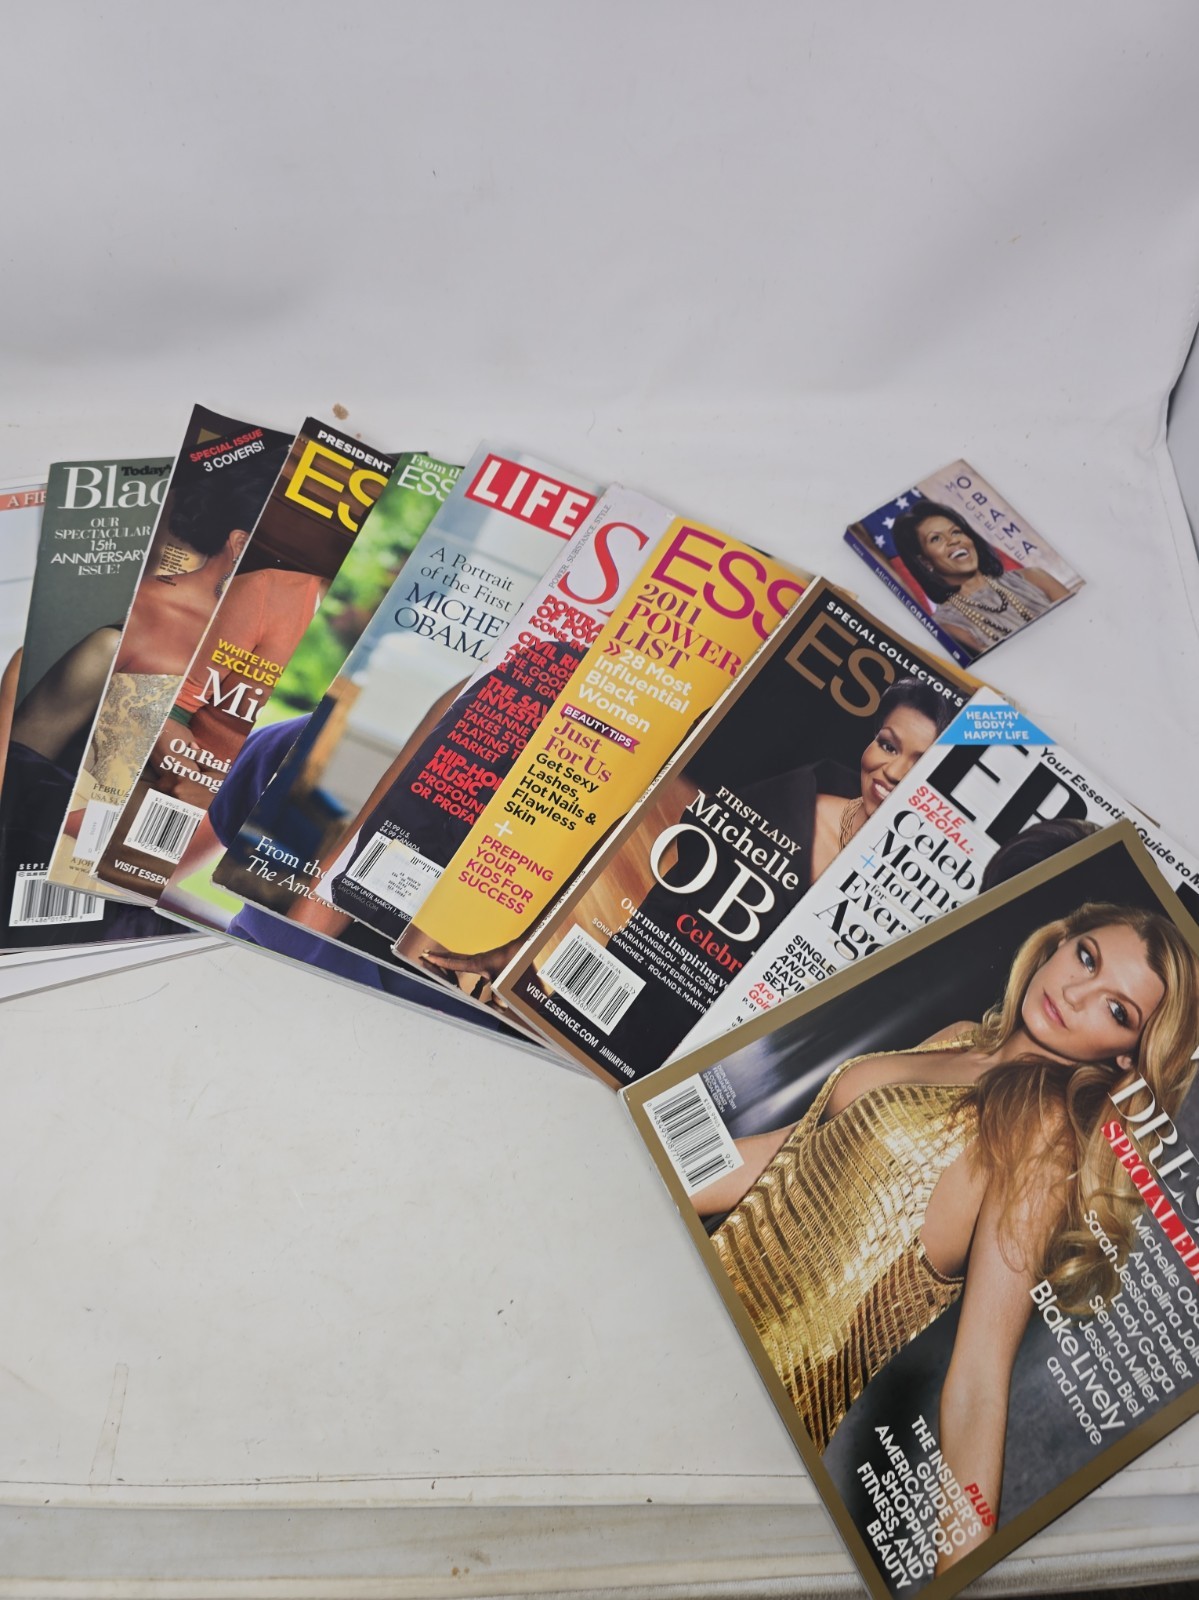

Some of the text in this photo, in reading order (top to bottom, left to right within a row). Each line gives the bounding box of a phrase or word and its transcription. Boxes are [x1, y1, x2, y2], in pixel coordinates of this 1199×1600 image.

[189, 428, 264, 463] SPECIAL ISSUE
[203, 440, 266, 472] 3 COVERS!
[317, 429, 392, 475] PRESIDENT
[411, 453, 447, 475] From
[7, 495, 20, 508] A
[284, 440, 389, 533] ES
[397, 464, 456, 502] ESS
[472, 459, 591, 536] LIFE
[54, 526, 151, 540] SPECTACULAR
[90, 517, 119, 528] OUR
[945, 481, 1025, 561] MICHELLE
[957, 475, 1038, 555] OBAMA
[50, 550, 148, 564] ANNIVERSARY
[90, 539, 117, 551] 15th
[78, 564, 121, 576] ISSUE!
[420, 565, 513, 612] of the First
[430, 547, 515, 593] A Portrait
[651, 525, 806, 642] ESS
[404, 582, 511, 639] MICHE
[537, 605, 562, 622] OF
[637, 583, 702, 627] 2011
[218, 638, 260, 665] WHITE
[509, 643, 547, 668] AFTER
[518, 631, 557, 661] CIVIL
[528, 615, 586, 652] ICONS IN
[612, 621, 691, 671] LIST
[625, 601, 743, 677] POWER
[826, 601, 877, 645] SPECIAL
[878, 641, 964, 708] COLLECTOR'S
[504, 650, 567, 690] THE GOOD
[511, 668, 534, 688] THE
[594, 655, 691, 714] Influential
[619, 648, 693, 697] 28 Most
[784, 611, 896, 717] ES
[193, 666, 265, 723] Mi
[487, 675, 517, 700] THE
[578, 683, 651, 733] Women
[585, 670, 639, 706] Black
[455, 721, 509, 754] PLAYING
[463, 709, 506, 736] TAKES
[469, 701, 531, 737] JULIANNE
[554, 721, 602, 754] Just
[564, 705, 633, 748] BEAUTY TIPS
[964, 730, 1029, 740] HAPPY LIFE
[966, 711, 1019, 720] HEALTHY
[974, 720, 1014, 729] BODY+
[170, 738, 198, 761] On
[447, 730, 502, 763] MARKET
[543, 735, 613, 784] For Us
[160, 755, 226, 794] Strong
[426, 758, 484, 797] MUSIC
[527, 763, 580, 801] Lashes,
[535, 752, 600, 794] Get Sexy
[410, 782, 479, 826] OR PROFA
[503, 801, 537, 826] Skin
[511, 787, 577, 832] Flawless
[520, 776, 597, 826] Hot Nails &
[715, 786, 802, 855] FIRST LADY
[916, 785, 967, 828] STYLE
[1040, 747, 1191, 877] Your Guide to
[685, 789, 800, 891] Michelle
[908, 795, 975, 855] SPECIAL:
[19, 862, 50, 871] SEPT.
[114, 859, 170, 887] VISIT ESSEN
[246, 855, 277, 882] The
[255, 835, 300, 868] From
[476, 846, 517, 877] YOUR
[481, 834, 555, 882] PREPPING
[893, 810, 977, 891] Celeb
[458, 870, 526, 915] SUCCESS
[465, 858, 534, 903] KIDS FOR
[836, 870, 911, 936] Ever
[870, 884, 888, 900] for
[872, 864, 913, 907] Hot
[591, 917, 613, 938] SONIA
[612, 936, 644, 964] SANCHEZ
[647, 964, 678, 991] ROLAND
[618, 925, 645, 951] MARIAN
[642, 944, 671, 972] WRIGHT
[668, 965, 703, 998] EDELMAN
[620, 897, 644, 922] Our
[641, 912, 672, 946] most
[667, 934, 721, 987] inspiring
[625, 918, 645, 938] MAYA
[642, 931, 677, 963] ANGELOU
[680, 963, 695, 980] BILL
[694, 975, 719, 997] COSBY
[676, 914, 744, 974] Celebr
[785, 944, 826, 981] SAVED
[793, 935, 837, 976] SINGLE
[763, 971, 789, 997] SEX
[777, 955, 806, 979] AND
[754, 982, 775, 1001] Are
[526, 983, 636, 1079] VISIT ESSENCE.COM JANUARY 2009
[1102, 1121, 1177, 1233] SPECIAL
[1132, 1214, 1181, 1288] Michelle
[1084, 1209, 1193, 1381] Sarah Jessica Parker
[1129, 1251, 1183, 1329] Angelina
[1029, 1279, 1126, 1431] Blake Lively
[1089, 1294, 1160, 1404] Sienna Miller
[1111, 1292, 1176, 1394] Lady Gaga
[1079, 1320, 1146, 1418] Jessica Biel
[1047, 1356, 1103, 1446] and more
[874, 1425, 954, 1557] AMERICA'S TOP
[911, 1414, 982, 1538] THE INSIDER'S
[857, 1461, 924, 1580] FITNESS, AND
[881, 1470, 939, 1575] SHOPPING,
[916, 1462, 967, 1547] GUIDE TO
[964, 1482, 996, 1528] PLUS
[866, 1519, 912, 1590] BEAUTY
